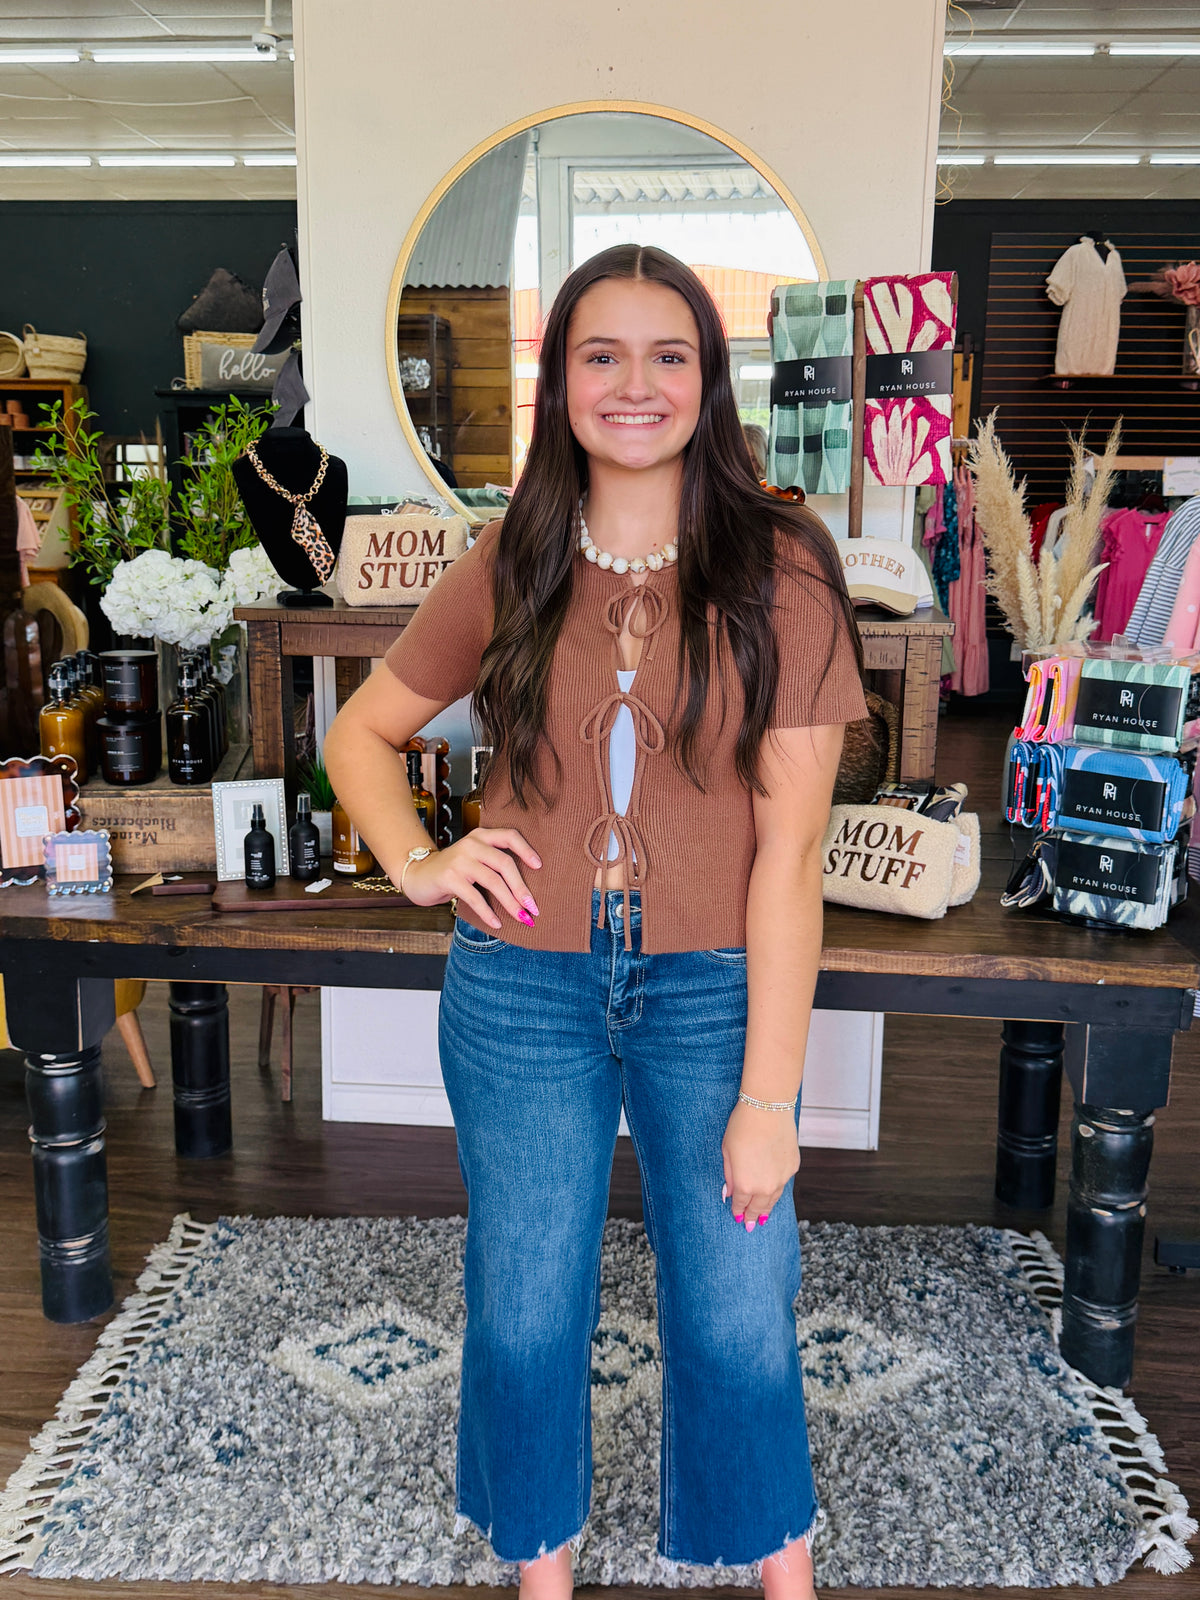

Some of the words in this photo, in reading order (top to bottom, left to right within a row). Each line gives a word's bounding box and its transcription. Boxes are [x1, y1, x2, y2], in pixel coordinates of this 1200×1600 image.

[219, 350, 276, 381] hello
[784, 388, 805, 397] RYAN
[808, 387, 837, 395] HOUSE
[880, 383, 903, 392] RYAN
[906, 381, 936, 390] HOUSE
[365, 530, 446, 558] MOM
[1092, 712, 1119, 723] RYAN
[1123, 717, 1158, 728] HOUSE
[1075, 804, 1102, 815] RYAN
[1106, 809, 1141, 822] HOUSE
[92, 817, 176, 831] Blueberries
[110, 831, 159, 845] Maine
[834, 818, 925, 857] MOM
[823, 848, 927, 889] STUFF
[1072, 875, 1099, 887] RYAN
[1103, 882, 1138, 895] HOUSE
